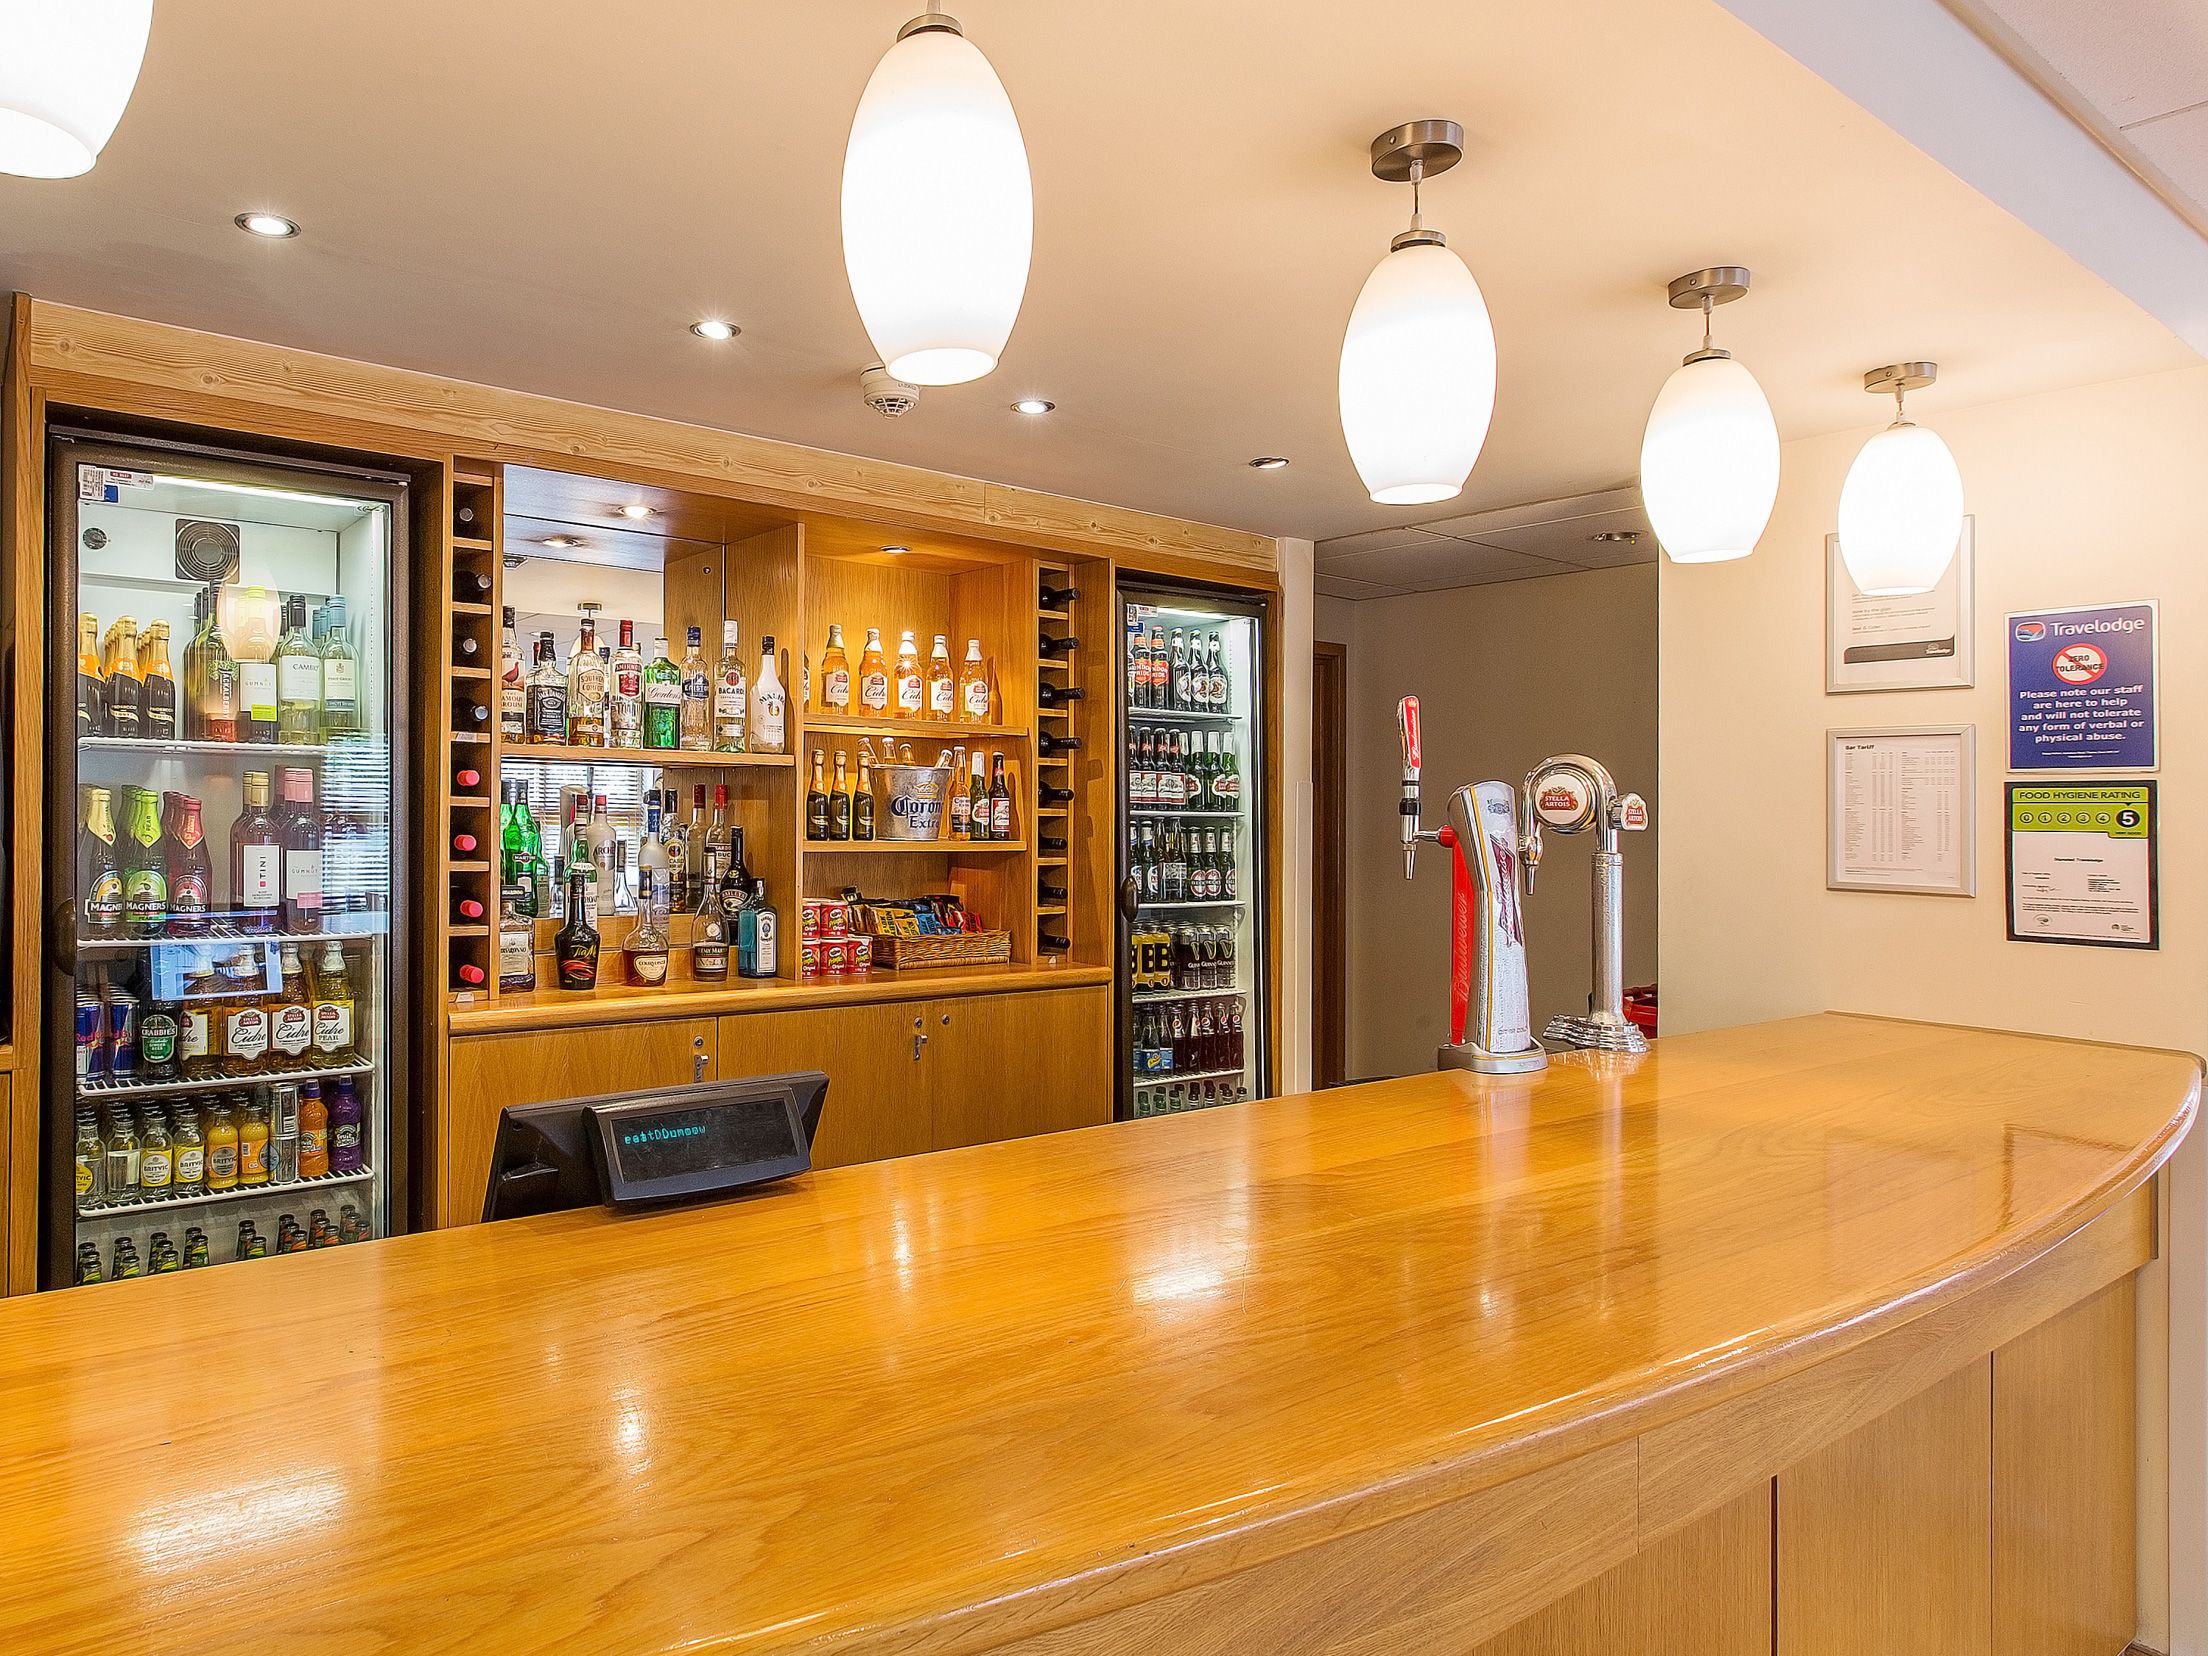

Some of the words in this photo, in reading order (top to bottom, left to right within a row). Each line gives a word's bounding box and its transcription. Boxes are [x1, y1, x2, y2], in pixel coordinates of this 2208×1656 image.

[2050, 618, 2145, 636] Travelodge
[2020, 690, 2057, 699] Please
[2060, 688, 2087, 697] note
[2090, 687, 2110, 695] our
[2114, 684, 2144, 694] staff
[2055, 699, 2082, 708] here
[2101, 697, 2128, 707] help
[2021, 712, 2042, 720] and
[2045, 711, 2066, 719] will
[2070, 710, 2090, 719] not
[2093, 708, 2142, 718] tolerate
[2019, 724, 2040, 733] any
[2042, 722, 2070, 731] form
[2073, 721, 2086, 730] of
[2089, 720, 2127, 729] verbal
[2130, 720, 2144, 728] or
[2035, 733, 2083, 743] physical
[2086, 732, 2126, 741] abuse.
[2019, 791, 2051, 799] FOOD
[2053, 791, 2098, 799] HYGIENE
[2101, 791, 2141, 799] RATING
[891, 795, 944, 818] Coron
[2121, 811, 2137, 826] 5
[90, 902, 122, 912] MAGNE
[126, 901, 167, 911] MAGNERS
[170, 903, 207, 913] MAGNERS
[275, 1023, 310, 1040] Cidre
[314, 1021, 344, 1035] Cidre
[231, 1027, 266, 1044] Cidre
[143, 1163, 168, 1171] BRITVIC
[180, 1160, 203, 1168] BRITVIC
